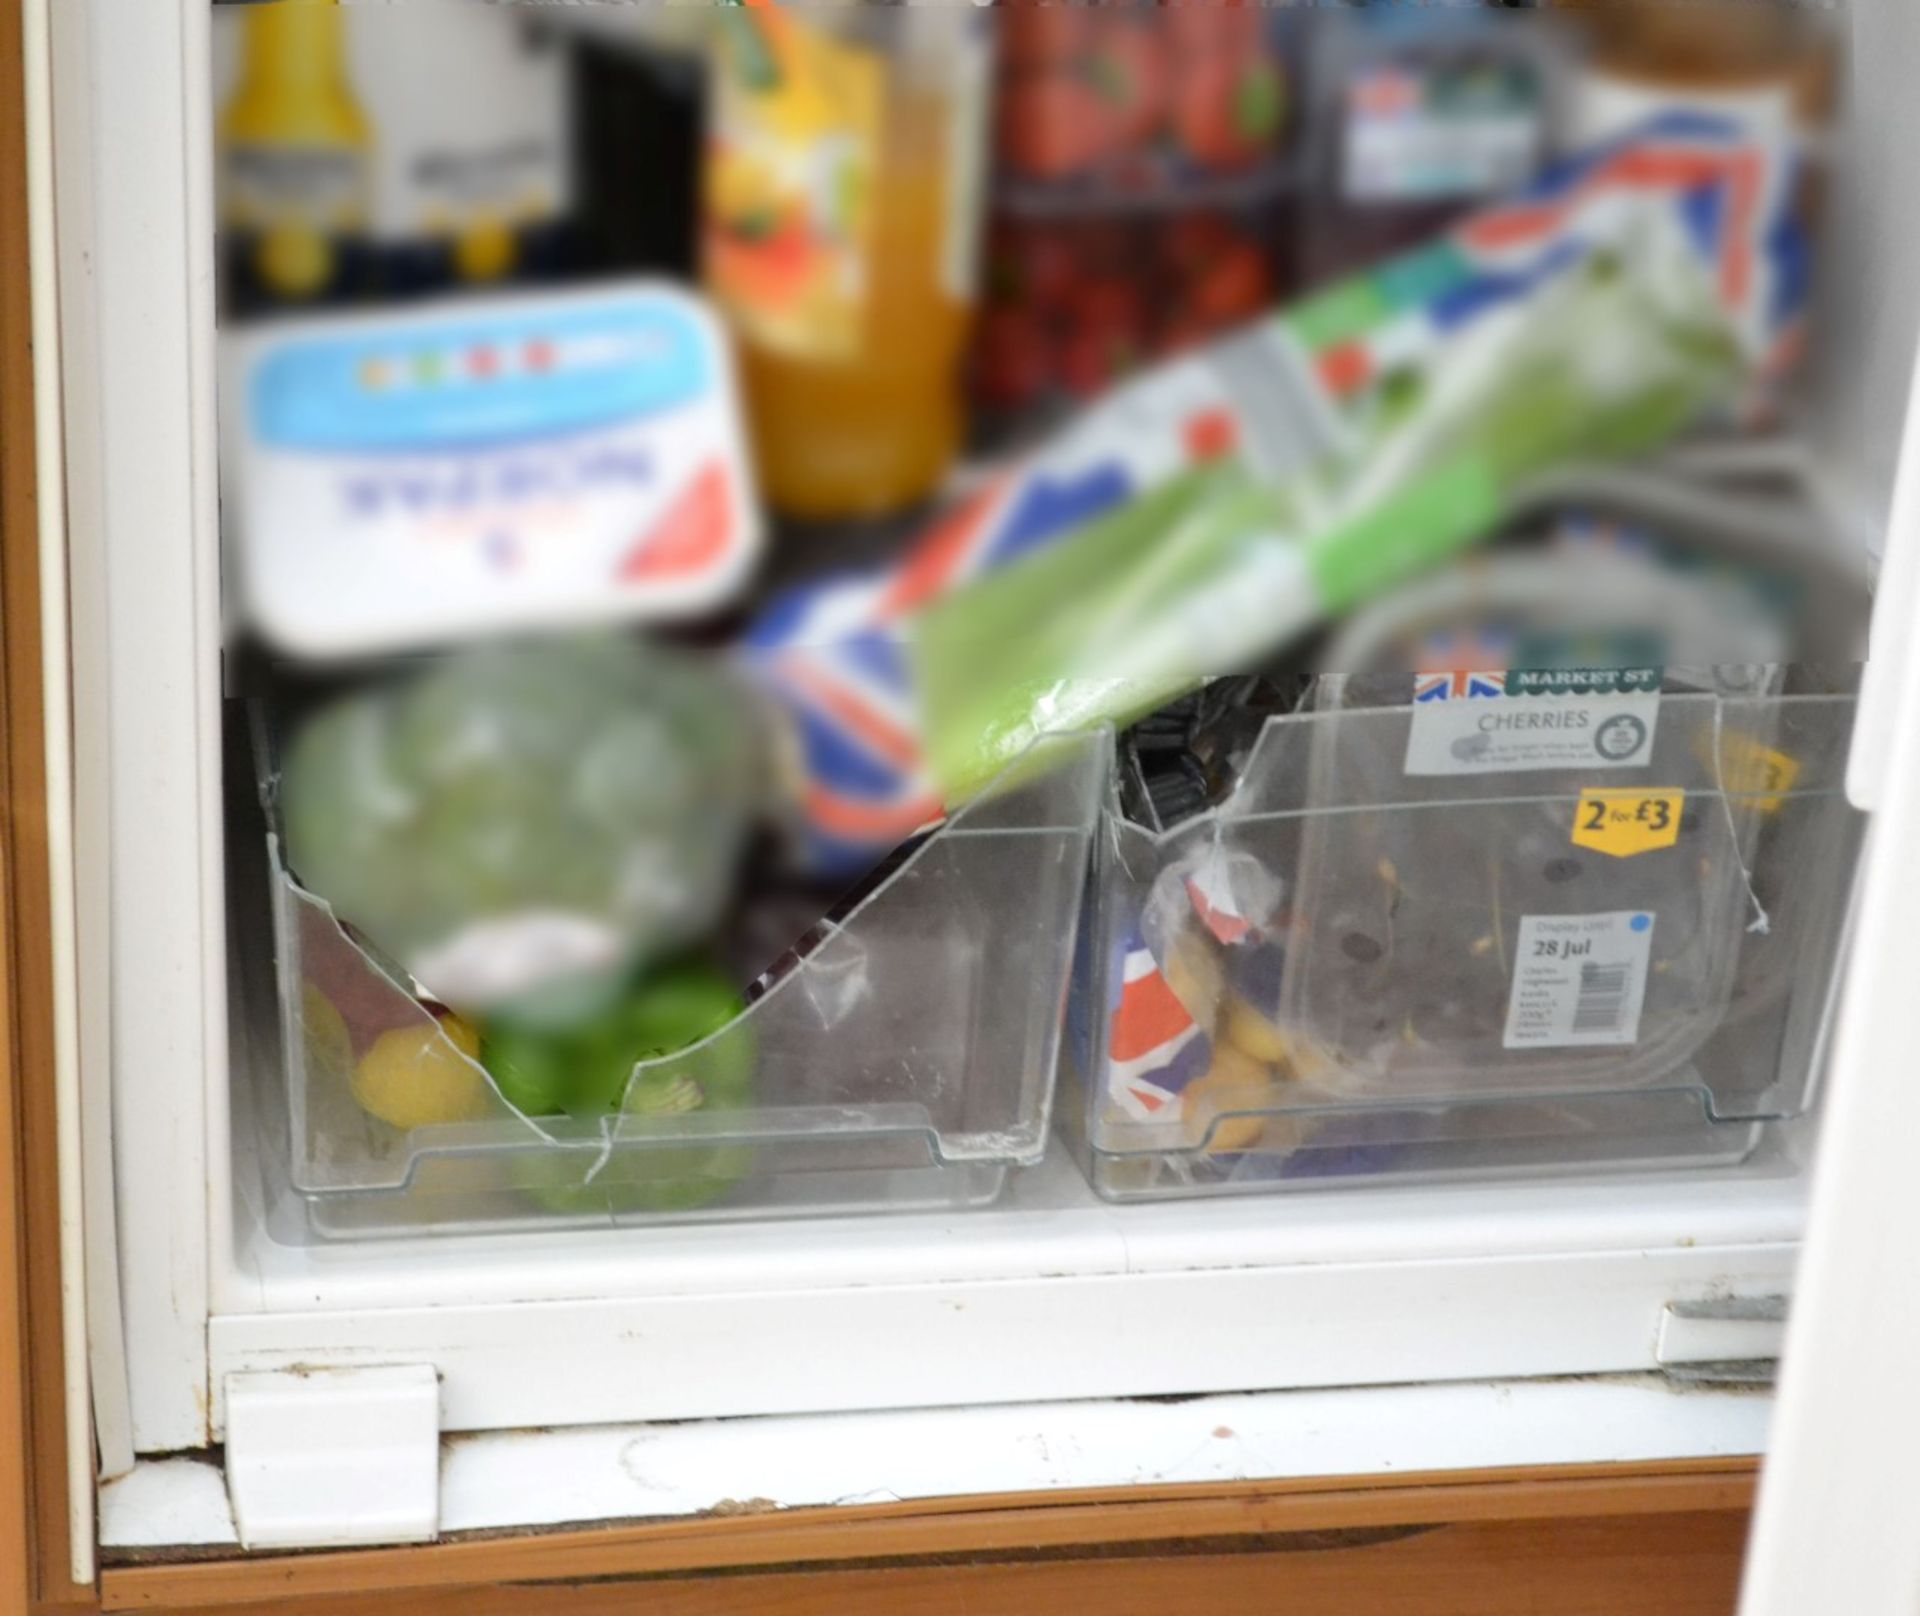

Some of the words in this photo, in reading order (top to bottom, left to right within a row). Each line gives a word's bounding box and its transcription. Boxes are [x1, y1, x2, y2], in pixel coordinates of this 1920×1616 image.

[1518, 670, 1619, 685] MARKET
[1623, 669, 1654, 683] ST
[1478, 710, 1589, 732] CHERRIES
[1583, 800, 1606, 830] 2
[1635, 799, 1670, 831] £3
[1533, 939, 1558, 957] 28
[1562, 938, 1592, 959] Jul
